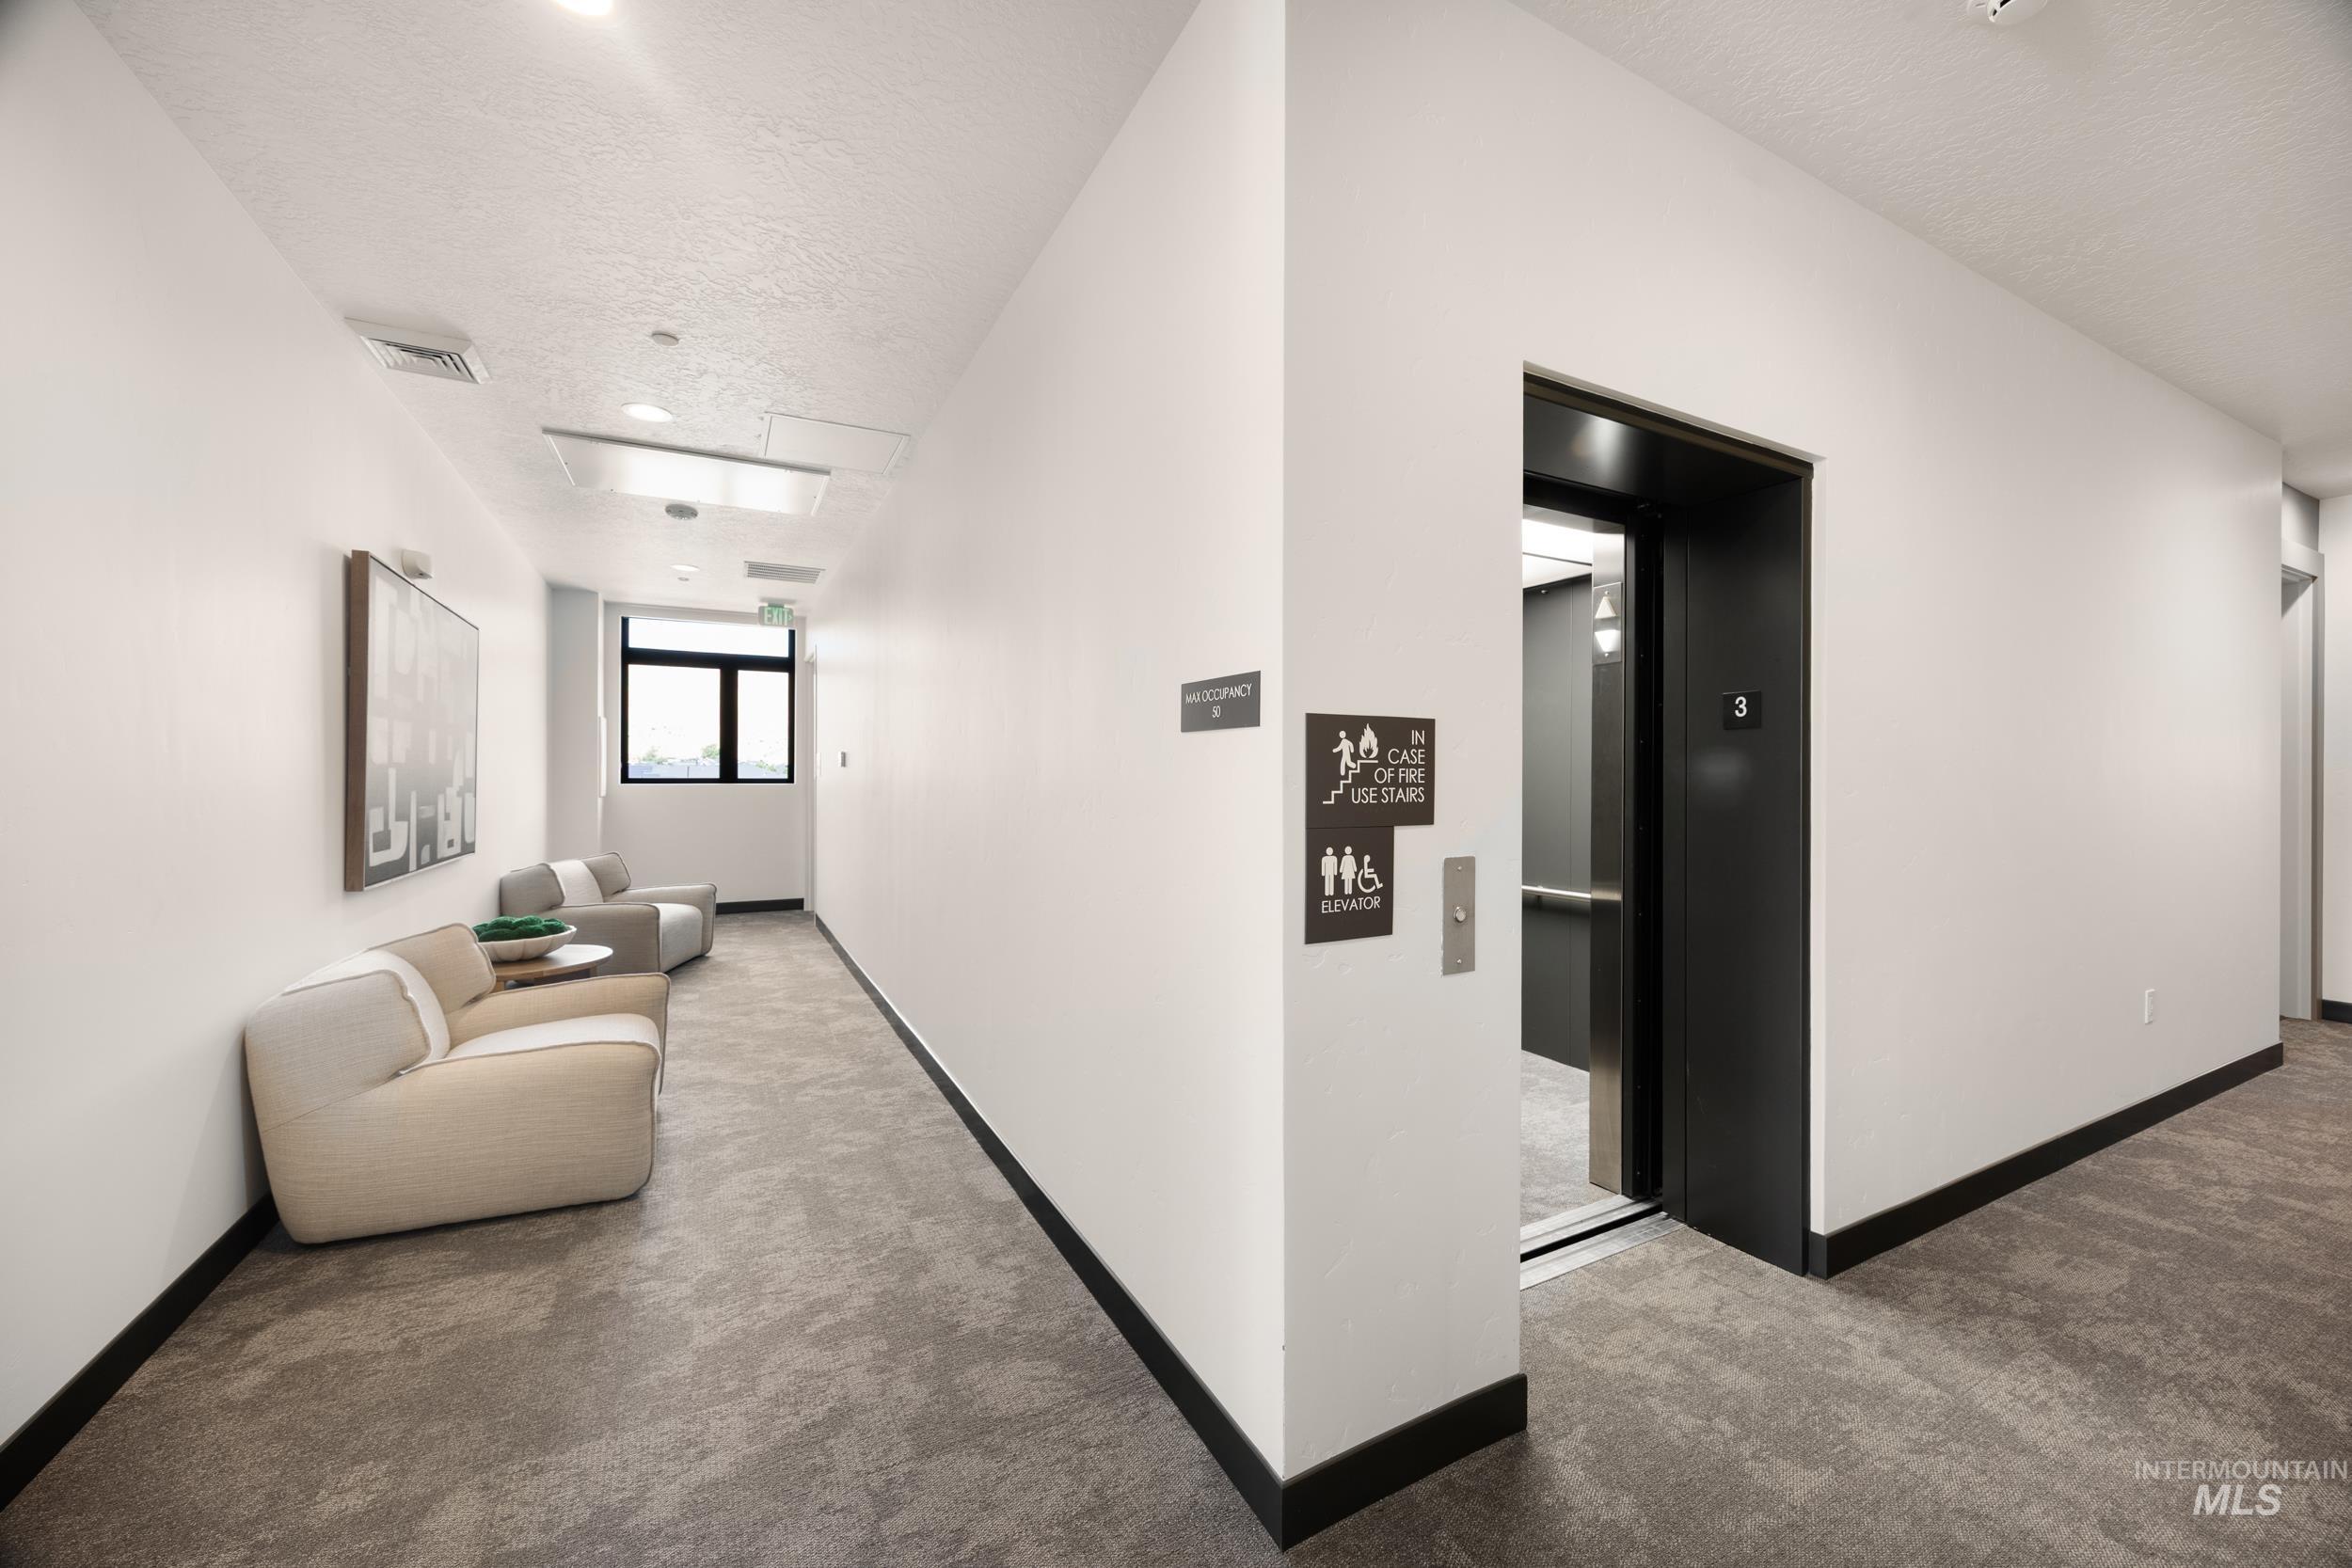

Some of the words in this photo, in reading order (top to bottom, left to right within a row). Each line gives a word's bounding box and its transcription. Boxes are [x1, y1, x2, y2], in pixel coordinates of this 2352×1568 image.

[764, 607, 789, 626] EXIT
[1185, 691, 1201, 704] MAX
[1201, 683, 1252, 703] OCCUPANCY
[1212, 705, 1221, 719] 50
[1735, 696, 1747, 718] 3
[1411, 729, 1425, 746] IN
[1388, 748, 1425, 765] CASE
[1374, 768, 1394, 784] OF
[1398, 768, 1425, 784] FIRE
[1351, 787, 1377, 804] USE
[1381, 786, 1425, 803] STAIRS
[1321, 895, 1381, 914] ELEVATOR
